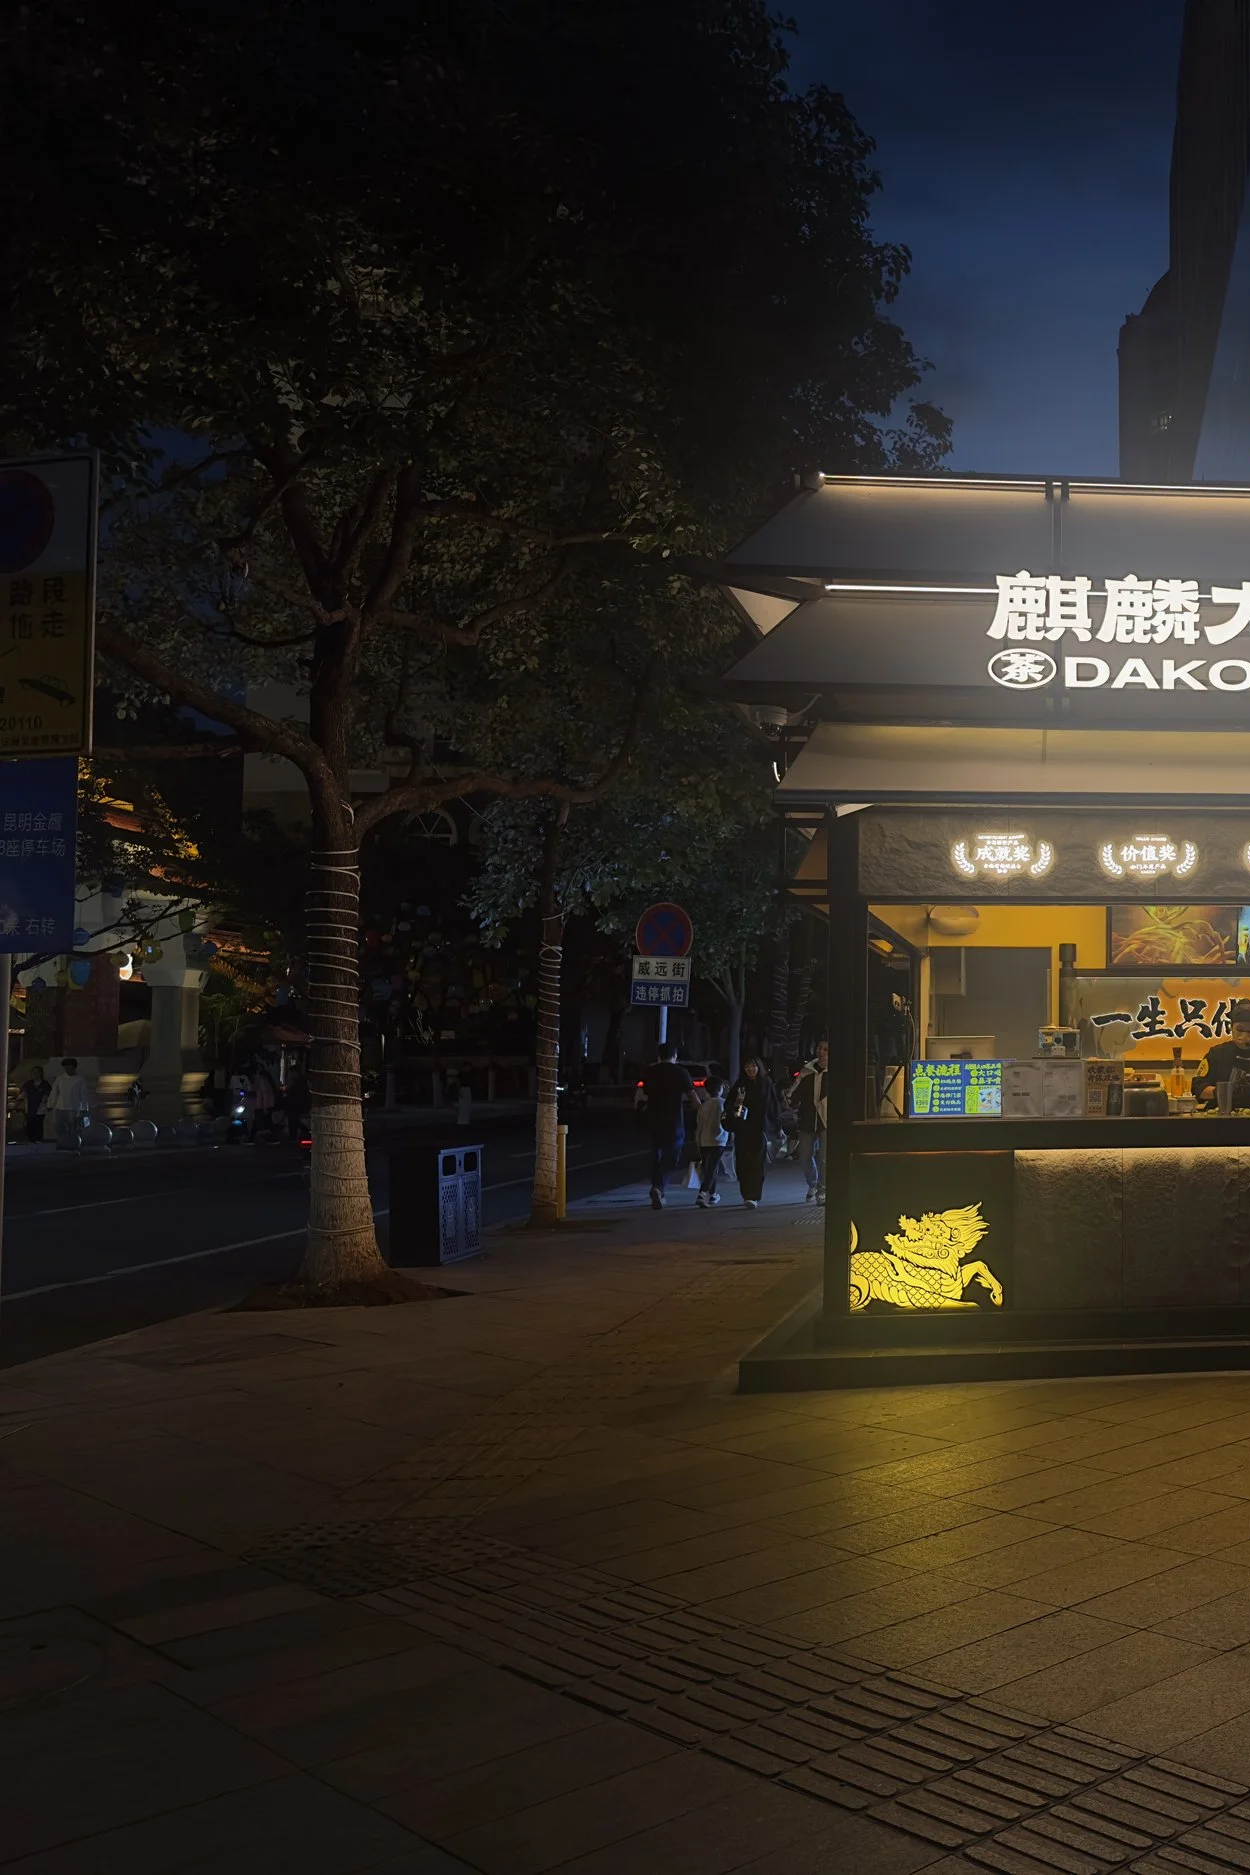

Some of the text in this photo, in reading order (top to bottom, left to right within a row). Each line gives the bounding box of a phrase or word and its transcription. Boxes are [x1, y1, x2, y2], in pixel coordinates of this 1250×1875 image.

[3, 811, 64, 833] 昆明金鹰
[1120, 844, 1177, 862] 价值奖
[637, 961, 686, 977] 威远街
[635, 985, 685, 1003] 违停抓拍
